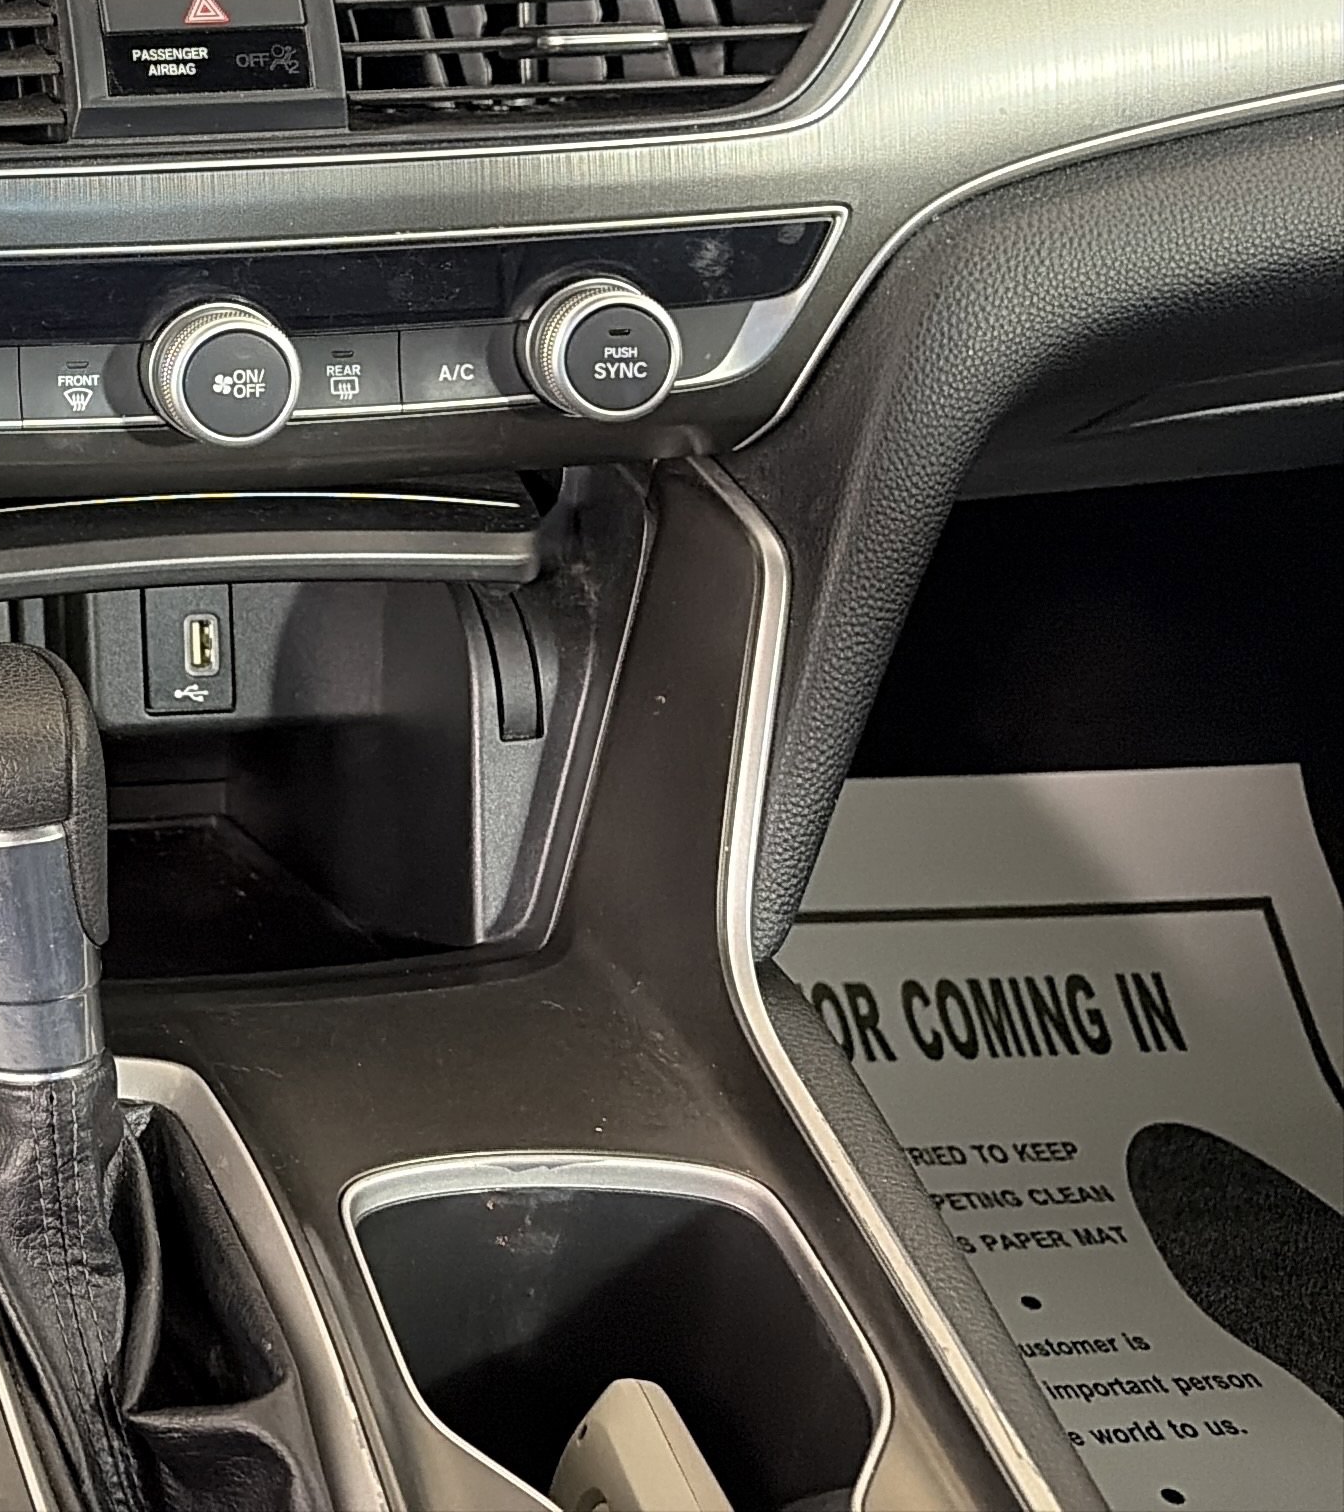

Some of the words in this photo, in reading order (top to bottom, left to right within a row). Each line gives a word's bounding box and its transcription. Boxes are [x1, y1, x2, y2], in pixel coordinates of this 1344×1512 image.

[132, 47, 209, 62] PASSENGER
[235, 52, 269, 68] OFF
[148, 63, 197, 76] AIRBAG
[603, 345, 638, 359] PUSH
[233, 368, 266, 384] ON/
[326, 364, 361, 377] REAR
[438, 363, 474, 382] A/C
[593, 361, 647, 379] SYNC
[57, 374, 100, 387] FRONT
[233, 382, 266, 399] OFF
[811, 980, 898, 1062] OR
[901, 972, 1113, 1061] COMING
[1115, 971, 1188, 1053] IN
[906, 1144, 967, 1167] RIED
[969, 1143, 1009, 1165] TO
[1012, 1141, 1078, 1163] KEEP
[928, 1189, 1023, 1211] PETING
[1027, 1184, 1116, 1206] CLEAN
[979, 1230, 1072, 1252] PAPER
[1077, 1225, 1129, 1246] MAT
[1018, 1337, 1119, 1358] ustomer
[1121, 1332, 1151, 1352] is
[1042, 1374, 1170, 1403] important
[1171, 1371, 1263, 1397] person
[1089, 1419, 1166, 1446] world
[1167, 1419, 1199, 1440] to
[1203, 1417, 1249, 1437] us.
